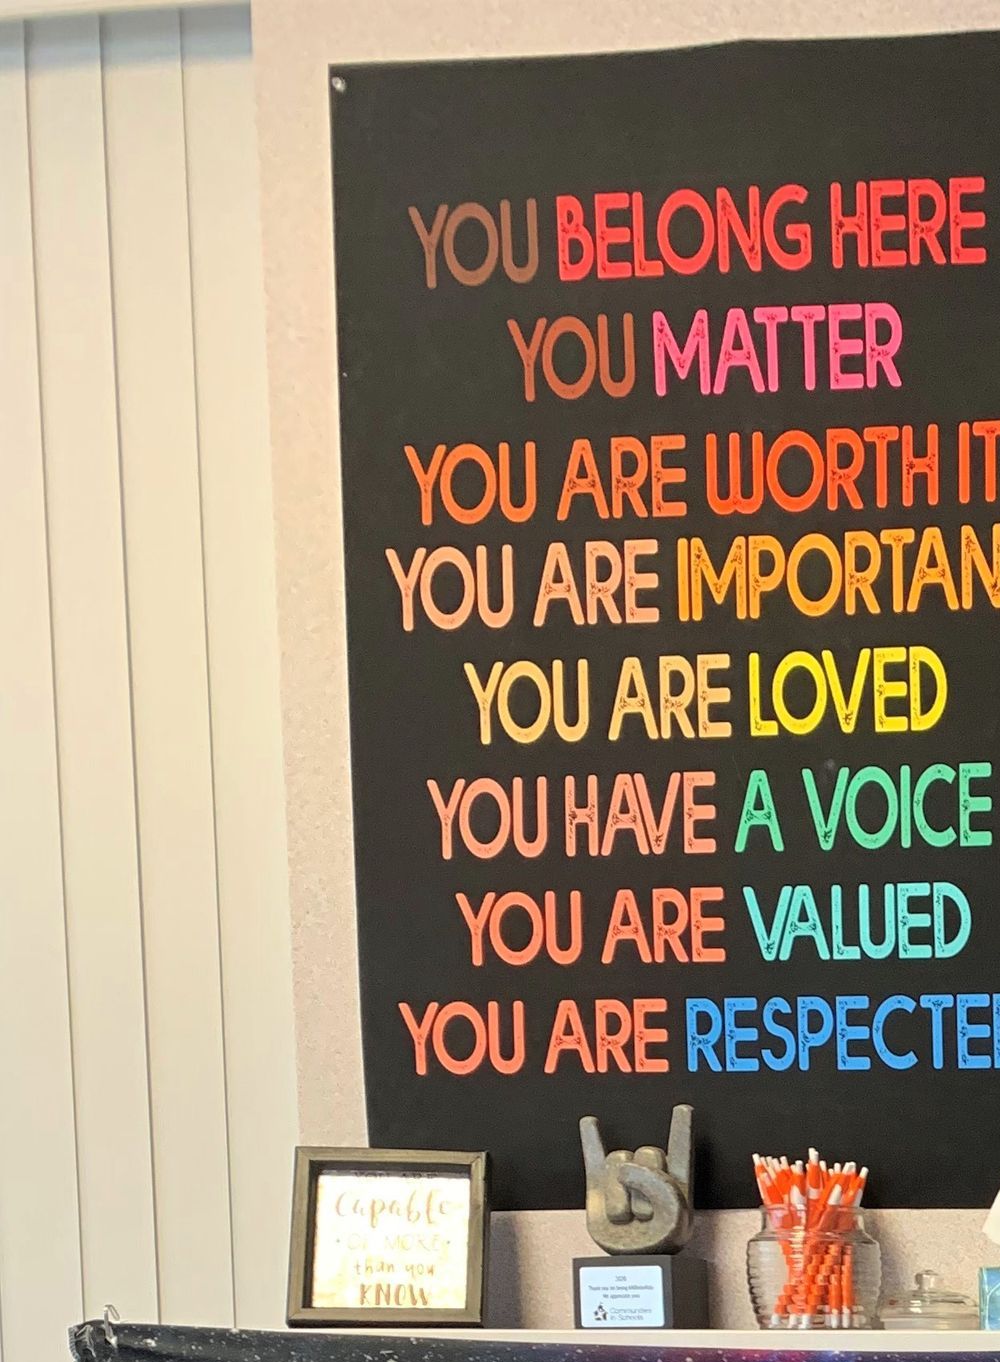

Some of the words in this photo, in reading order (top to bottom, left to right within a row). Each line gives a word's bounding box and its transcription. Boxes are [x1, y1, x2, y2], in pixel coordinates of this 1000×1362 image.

[408, 197, 539, 289] YOU
[554, 182, 814, 285] BELONG
[828, 175, 988, 271] HERE
[507, 312, 637, 403] YOU
[650, 300, 904, 399] MATTER
[404, 440, 539, 528] YOU
[556, 434, 688, 523] ARE
[704, 423, 941, 519] WORTH
[385, 544, 516, 633] YOU
[533, 539, 662, 628] ARE
[464, 659, 591, 746] YOU
[608, 653, 733, 742] ARE
[748, 646, 948, 738] LOVED
[426, 776, 550, 861] YOU
[564, 771, 717, 858] HAVE
[735, 770, 784, 853] A
[802, 763, 992, 851] VOICE
[455, 890, 584, 968] YOU
[601, 886, 726, 967] ARE
[743, 882, 971, 961] VALUED
[398, 1000, 526, 1077] YOU
[544, 998, 670, 1074] ARE
[360, 1283, 429, 1306] KNOW
